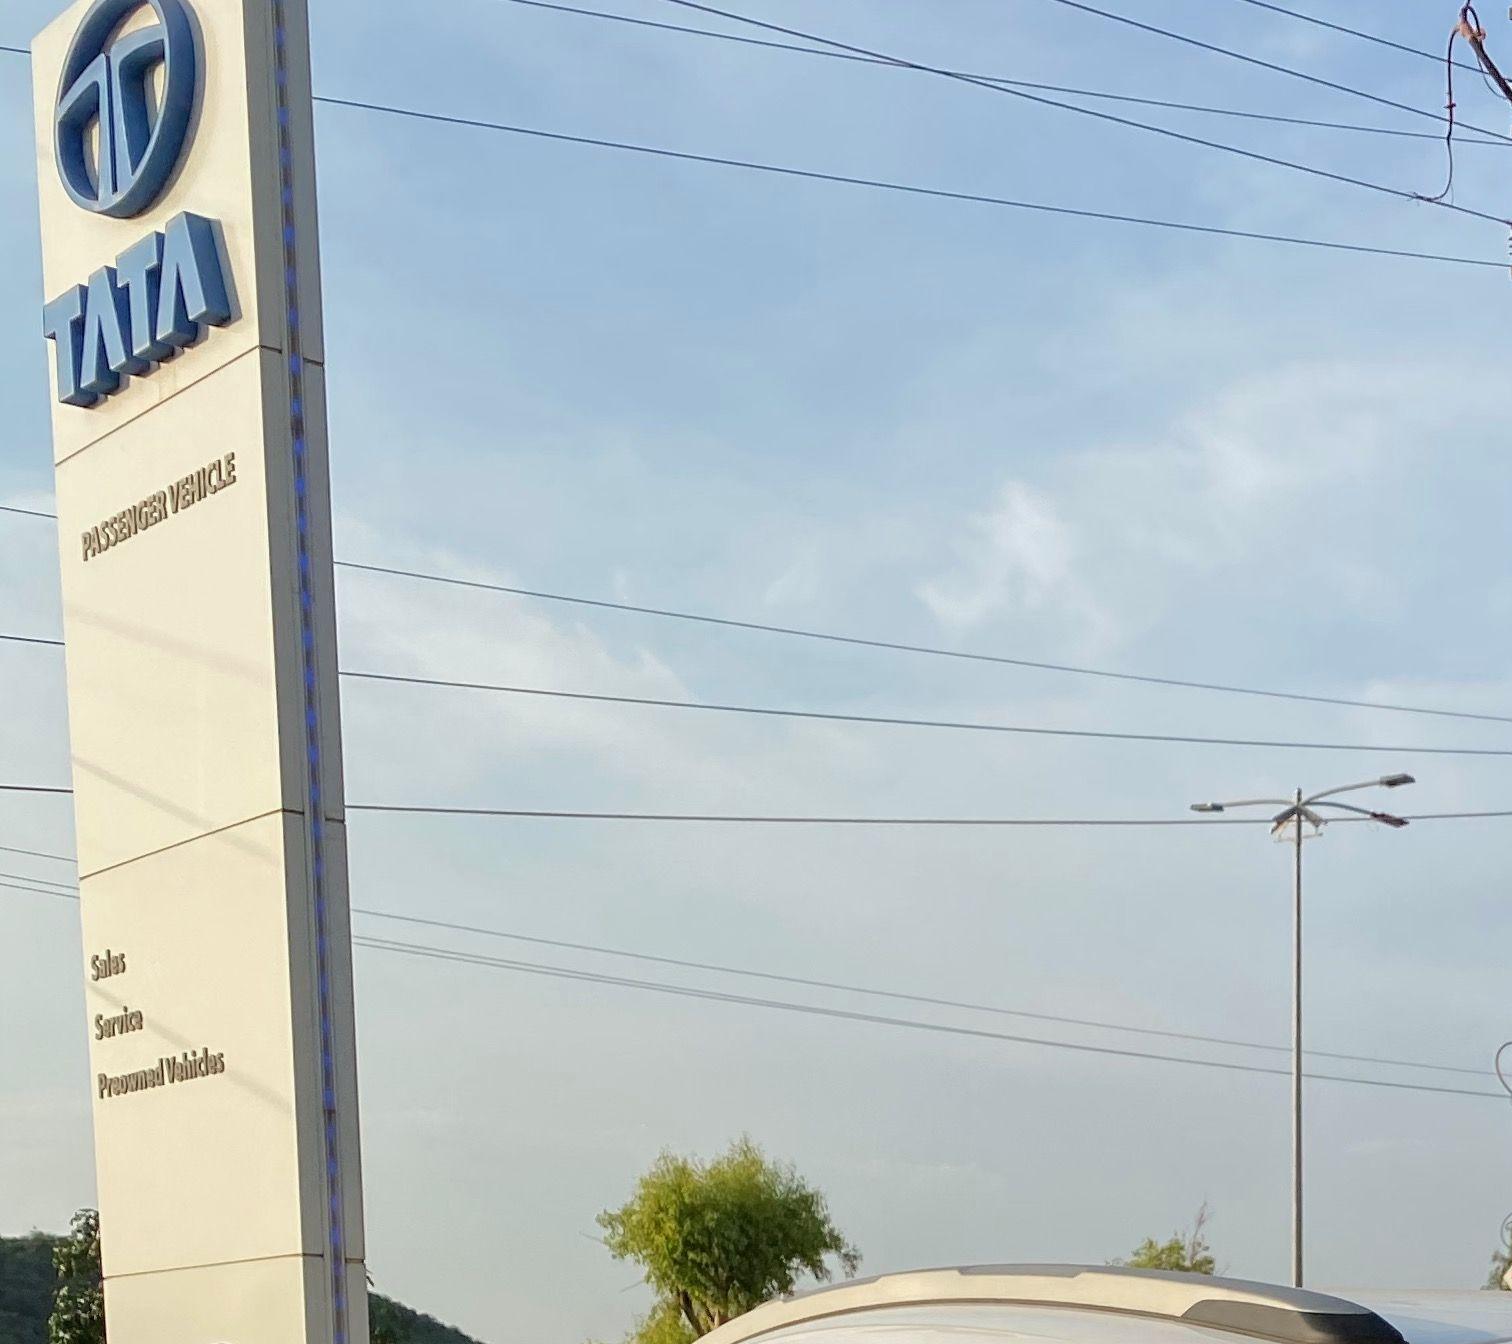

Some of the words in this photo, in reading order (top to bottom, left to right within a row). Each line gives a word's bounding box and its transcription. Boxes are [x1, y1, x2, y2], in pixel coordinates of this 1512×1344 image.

[43, 211, 236, 408] TATA
[81, 490, 168, 561] PASSENGER
[168, 451, 237, 514] VEHICLE
[91, 949, 126, 981] Sales
[95, 1006, 143, 1040] Service
[98, 1058, 165, 1099] Preowned
[166, 1047, 225, 1084] Vehicles
